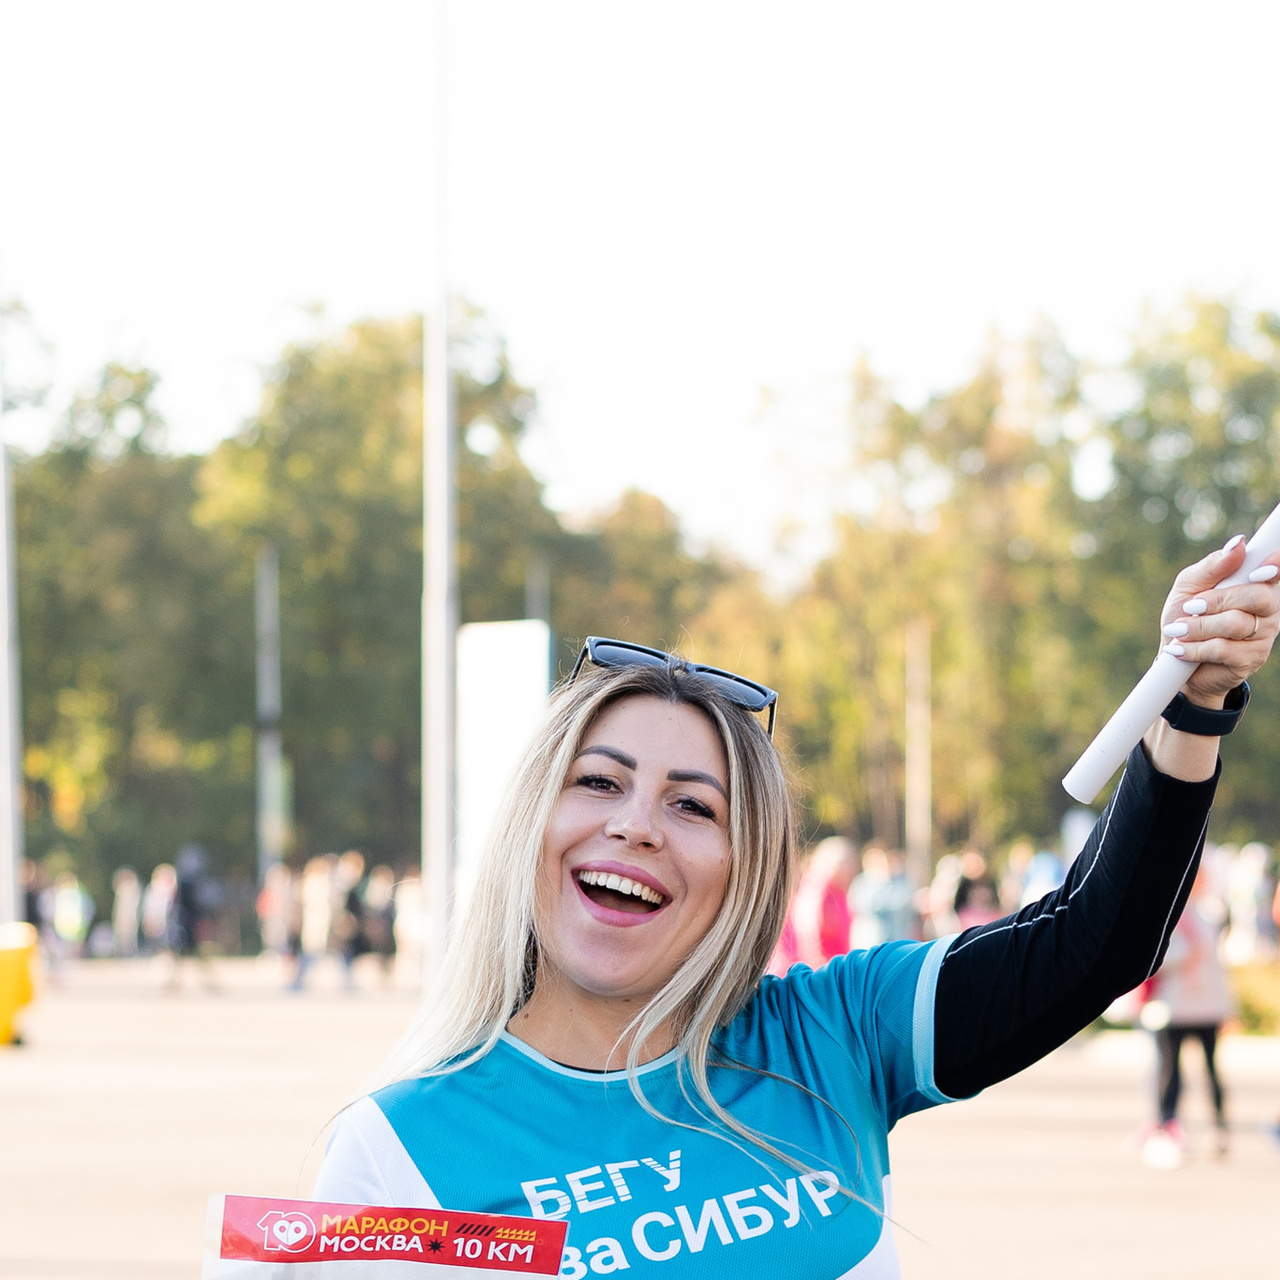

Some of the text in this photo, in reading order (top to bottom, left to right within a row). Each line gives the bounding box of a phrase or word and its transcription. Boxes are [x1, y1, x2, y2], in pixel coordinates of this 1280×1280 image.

[520, 1150, 681, 1220] БЕГУ
[320, 1214, 449, 1237] МАРАФОН
[631, 1170, 839, 1262] СИБУР
[319, 1235, 534, 1263] МОСКВА 10 КМ
